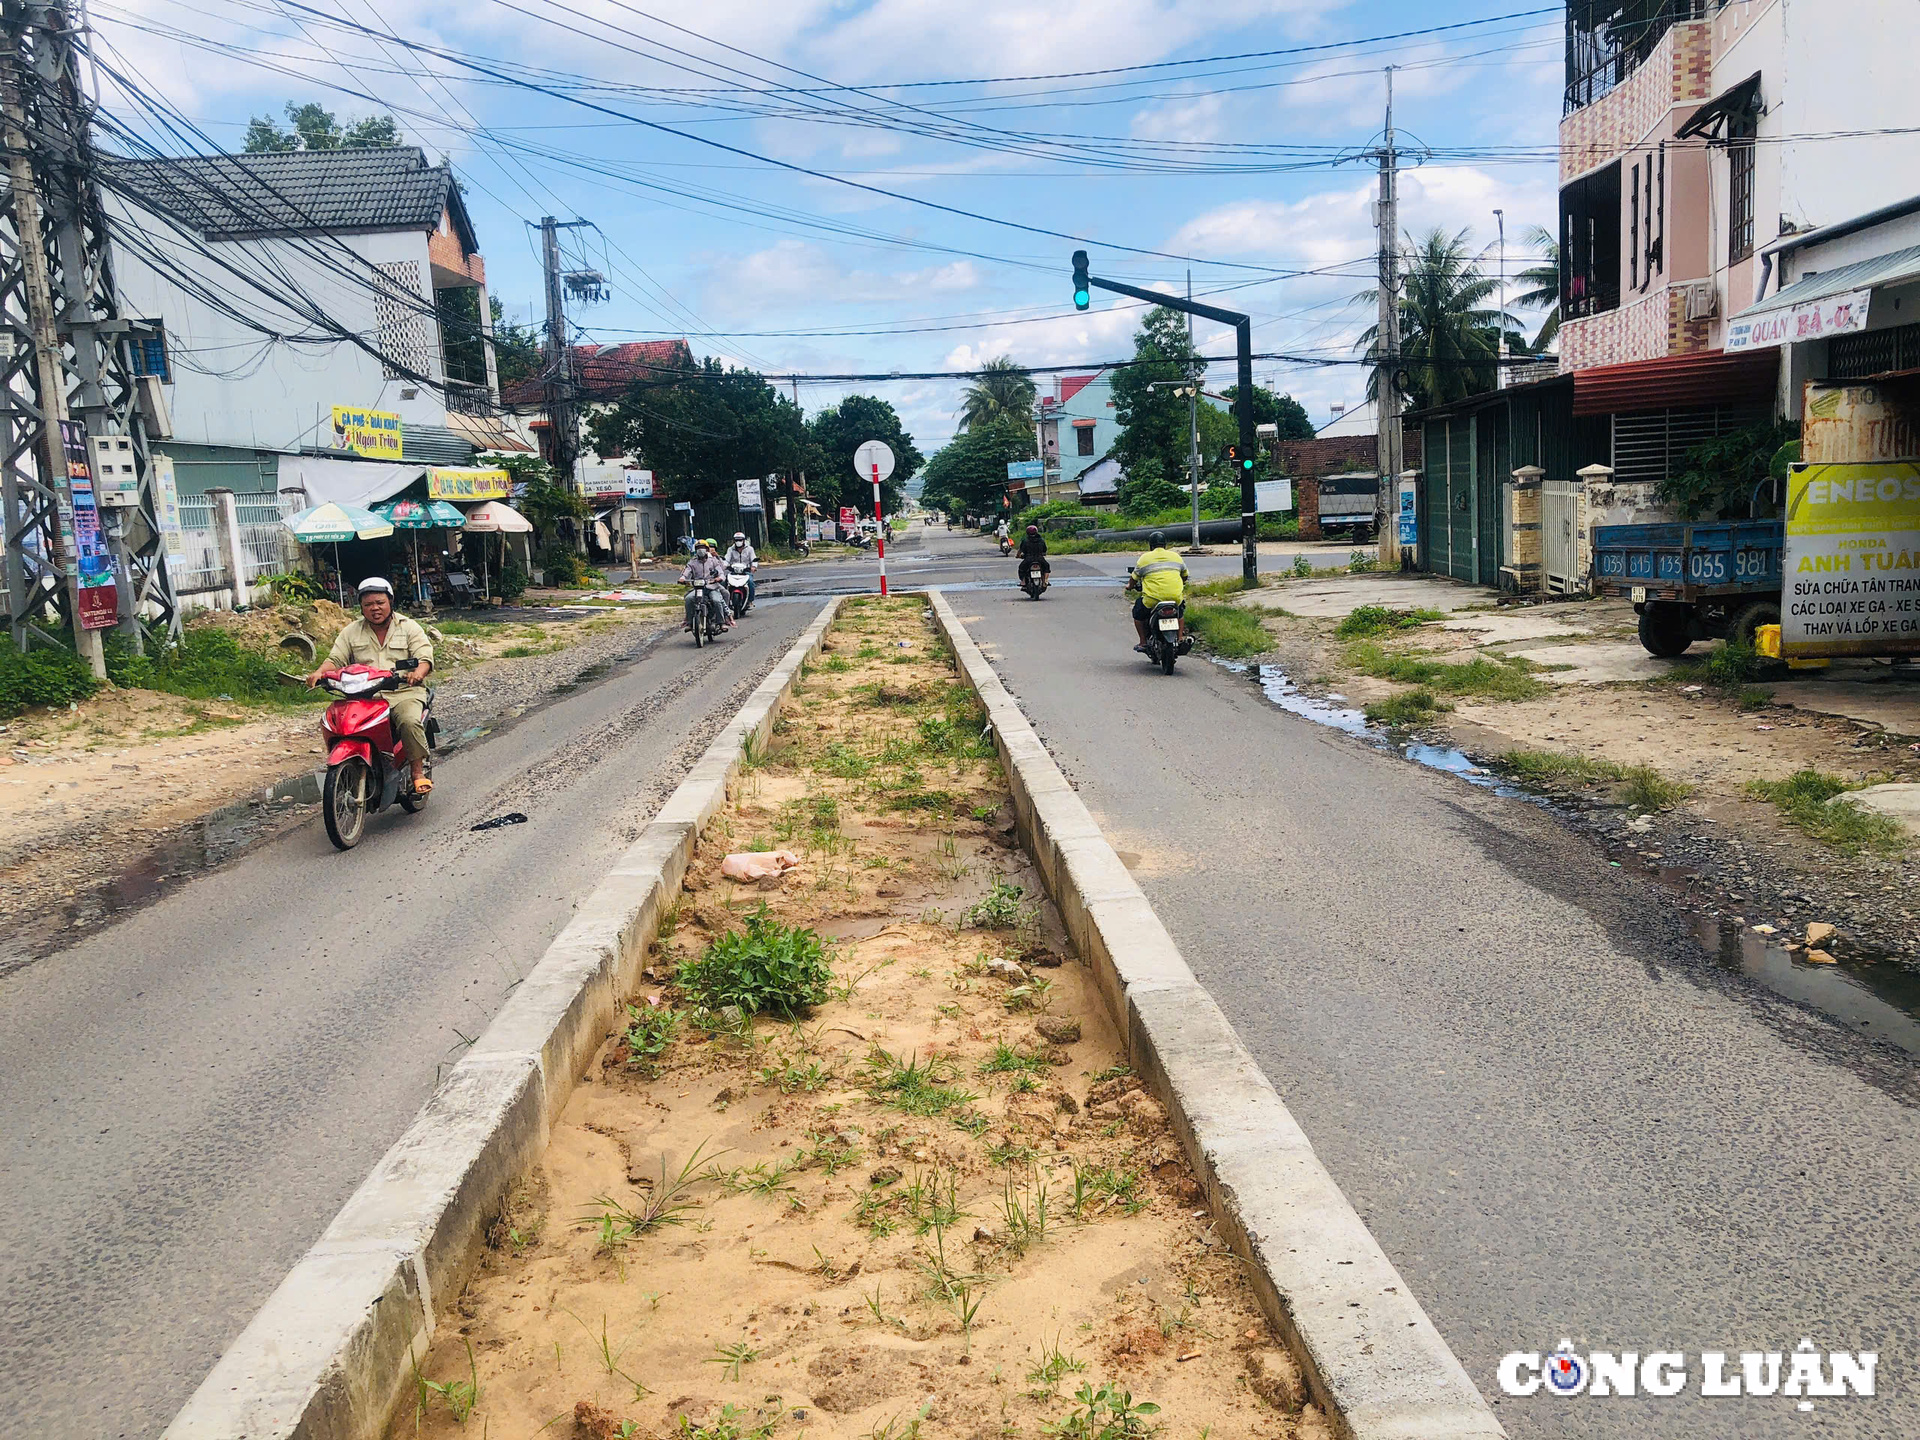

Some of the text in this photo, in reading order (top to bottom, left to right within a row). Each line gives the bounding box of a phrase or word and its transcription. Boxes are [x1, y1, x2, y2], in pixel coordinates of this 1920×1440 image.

[1752, 314, 1789, 345] QUÁN
[342, 411, 351, 425] CÀ
[353, 413, 364, 427] PHÊ
[384, 417, 398, 431] KHÁT
[1808, 477, 1920, 504] ENEOS
[1838, 538, 1887, 549] HONDA
[1603, 555, 1682, 574] 035 815 133
[1691, 553, 1725, 578] 035
[1735, 551, 1768, 577] 981
[1797, 554, 1850, 573] ANH
[1794, 579, 1820, 596] SỬA
[1824, 578, 1859, 594] CHỮA
[1861, 577, 1886, 593] TÂN
[1791, 600, 1816, 616] CÁC
[1819, 601, 1846, 617] LOẠI
[1849, 601, 1865, 613] XE
[1896, 600, 1912, 612] XE
[1803, 616, 1918, 635] THAY VÁ LỐP XE GA
